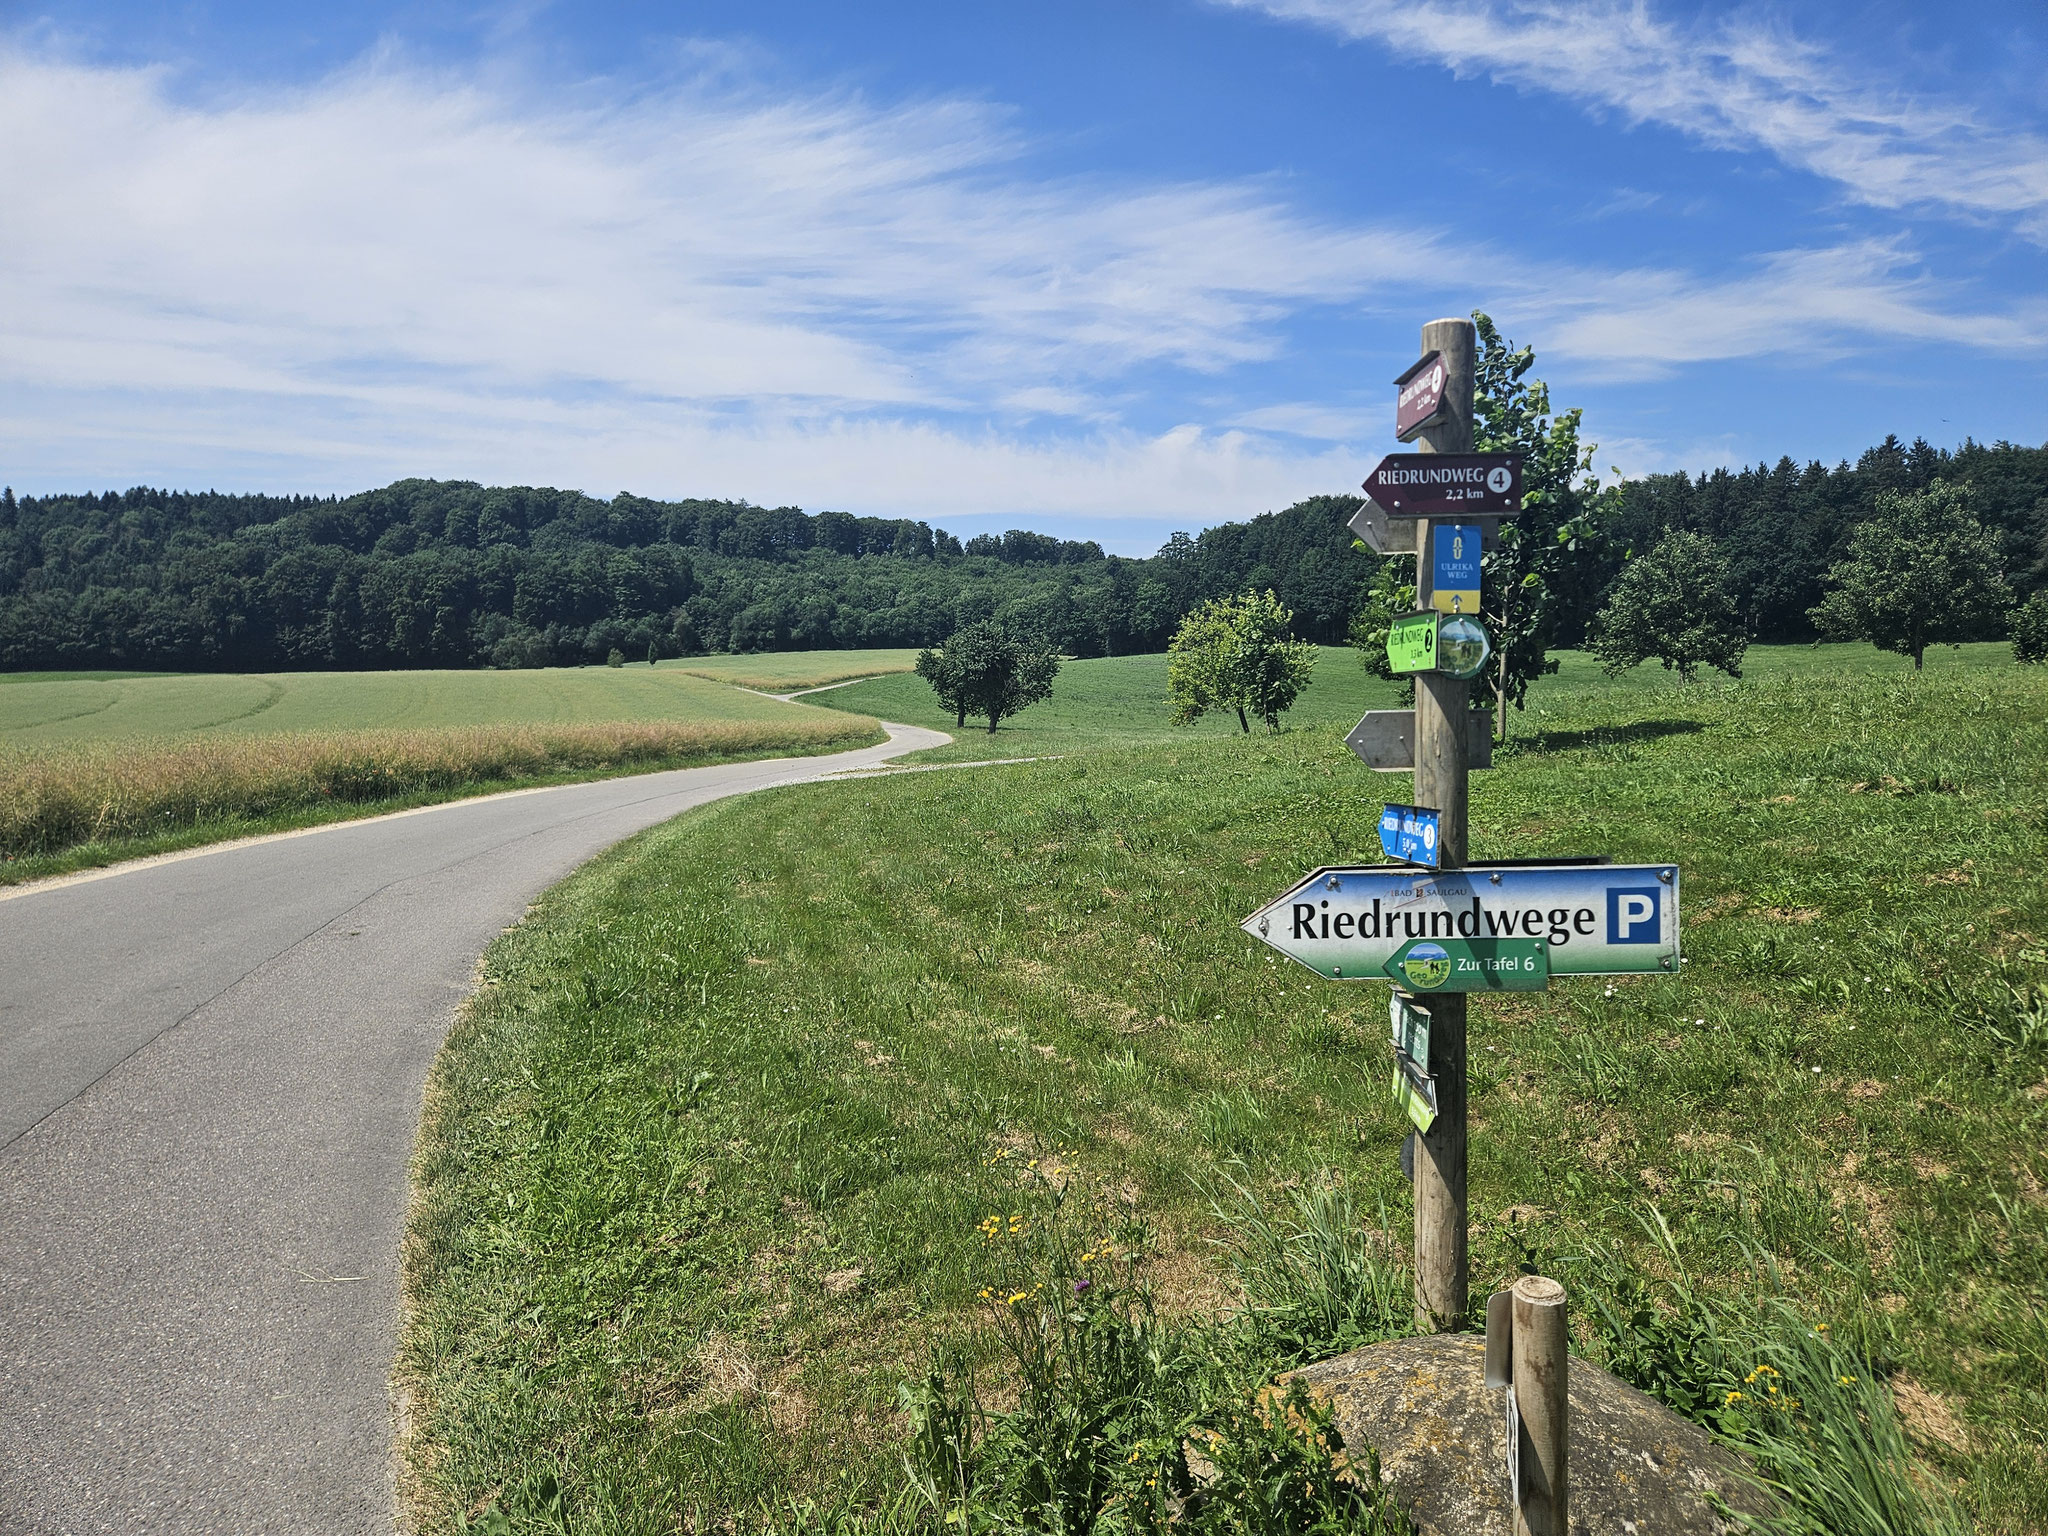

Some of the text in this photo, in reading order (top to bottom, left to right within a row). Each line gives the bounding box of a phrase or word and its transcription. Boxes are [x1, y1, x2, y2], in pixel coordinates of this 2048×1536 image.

[1378, 468, 1505, 488] RIEDRUNDWEG 4
[1445, 488, 1484, 501] 2,2 km
[1441, 563, 1474, 571] ULRIKA
[1447, 571, 1468, 579] WEG
[1394, 889, 1412, 897] BAD
[1293, 894, 1654, 946] Riedrundwege P
[1457, 957, 1535, 971] Zur Tafel 6
[1410, 971, 1428, 979] Geo
